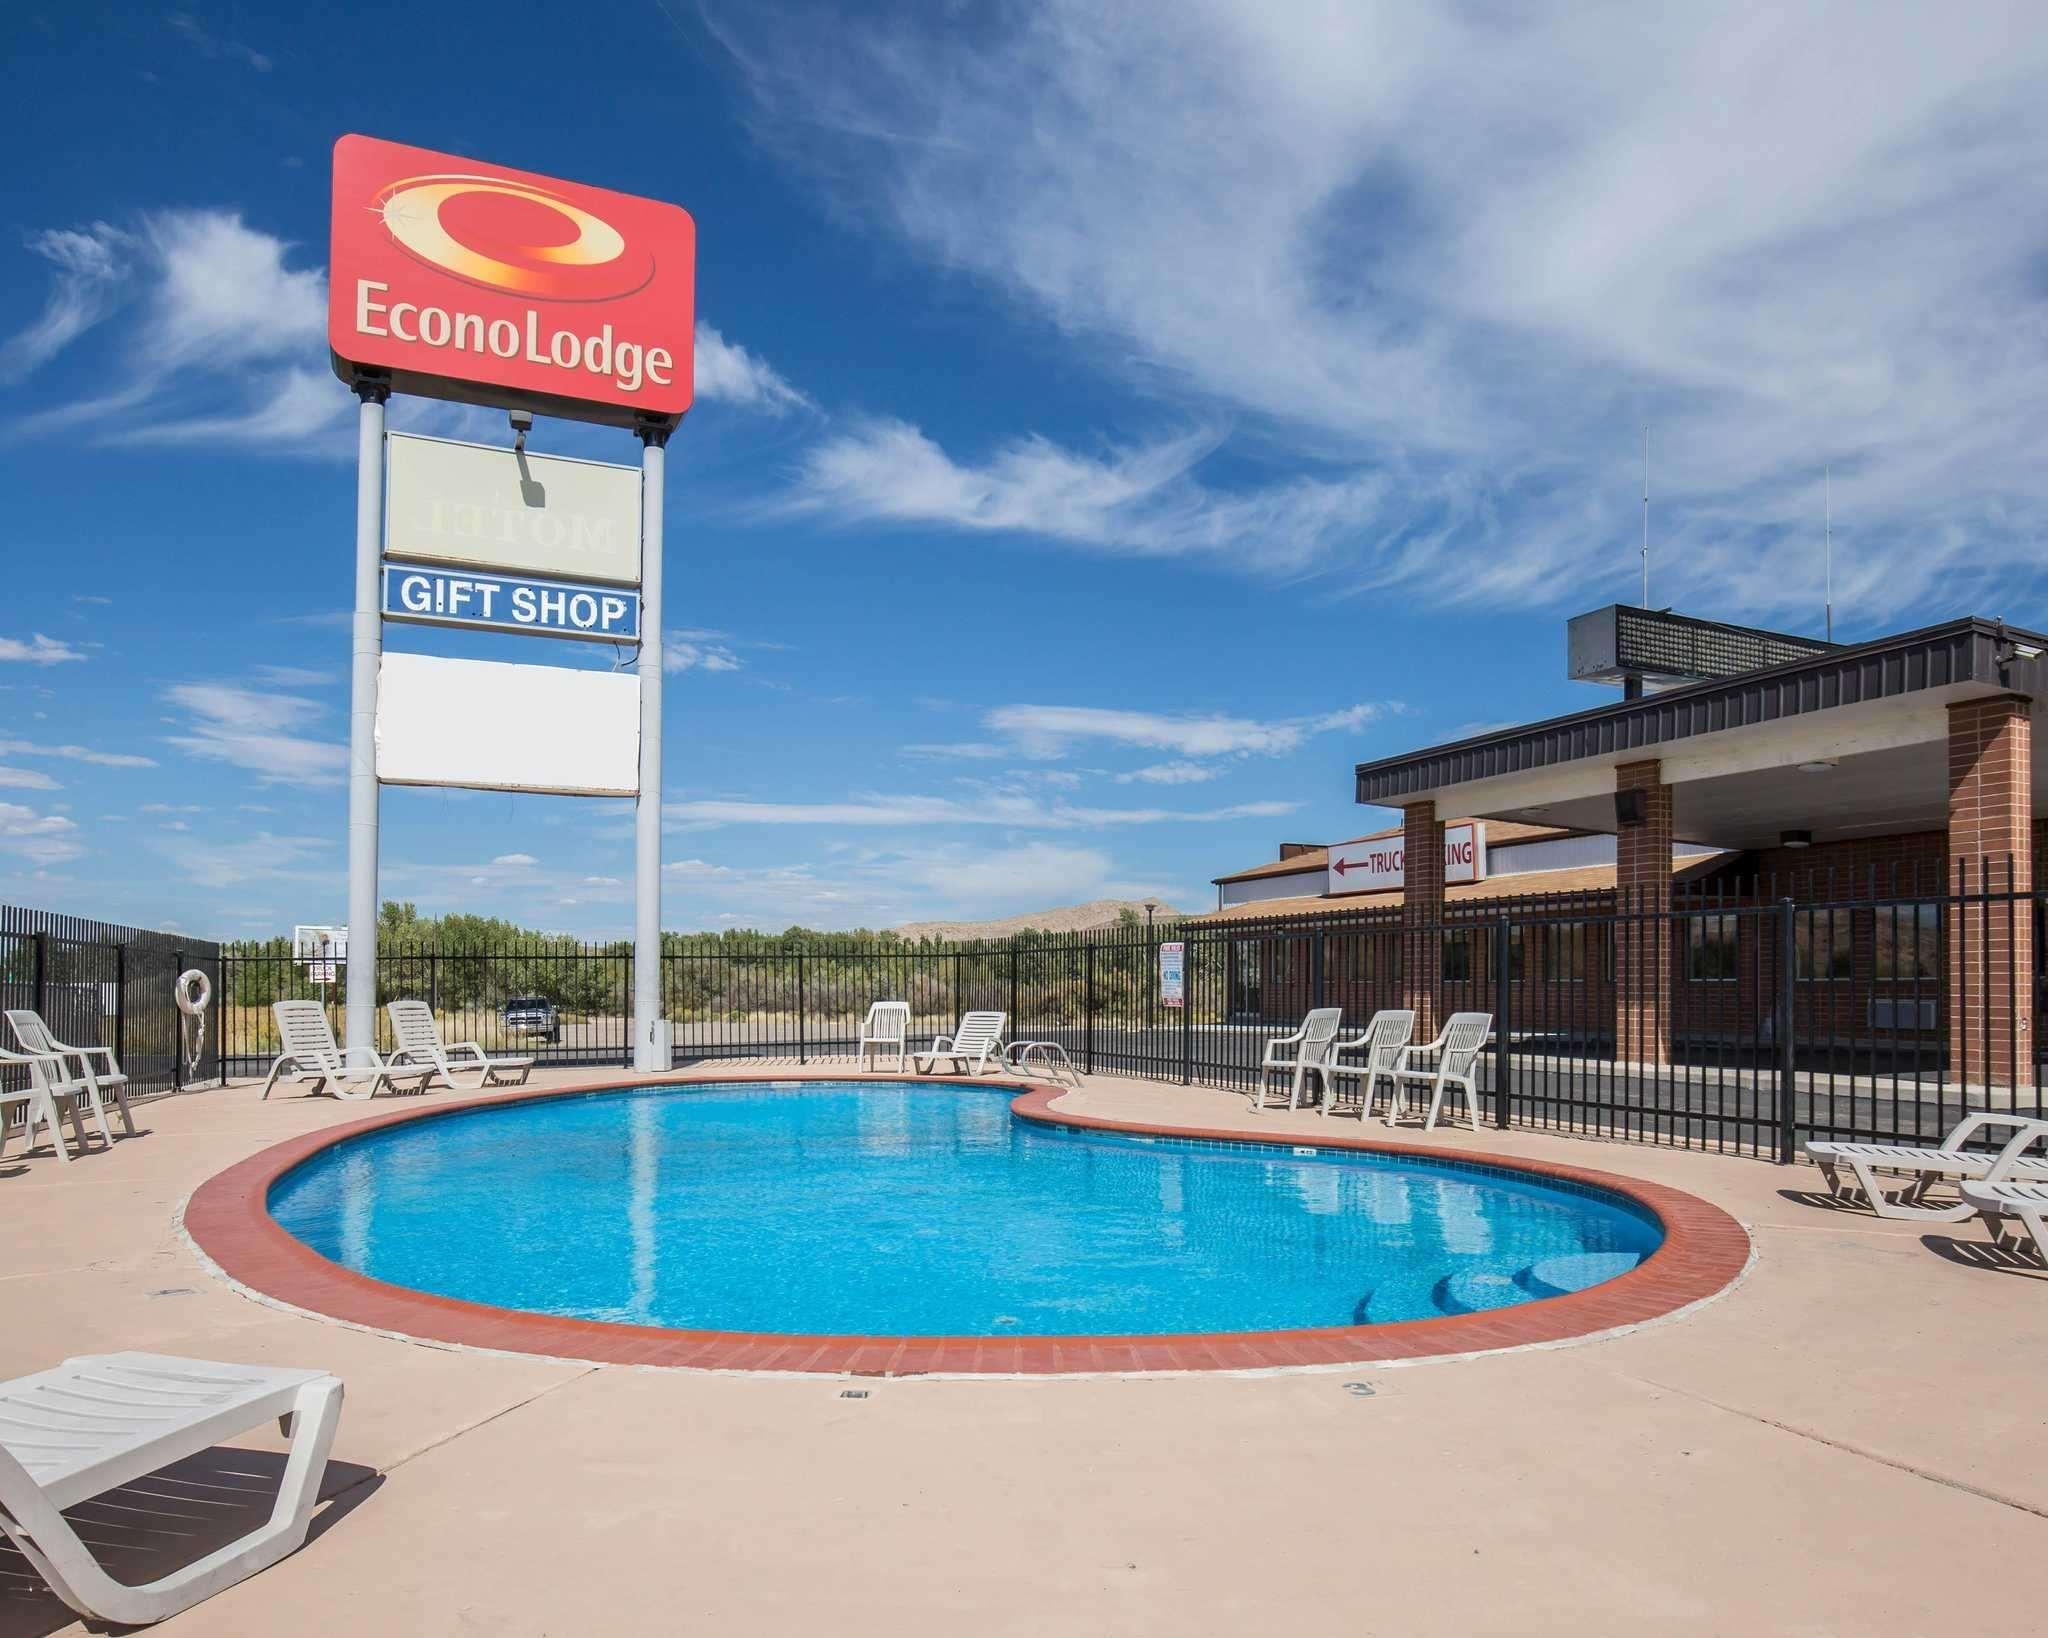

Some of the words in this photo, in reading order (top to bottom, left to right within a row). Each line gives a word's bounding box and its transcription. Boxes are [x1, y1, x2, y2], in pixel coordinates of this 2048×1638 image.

[355, 278, 673, 392] EconoLodge
[401, 575, 500, 618] GIFT
[512, 586, 627, 631] SHOP
